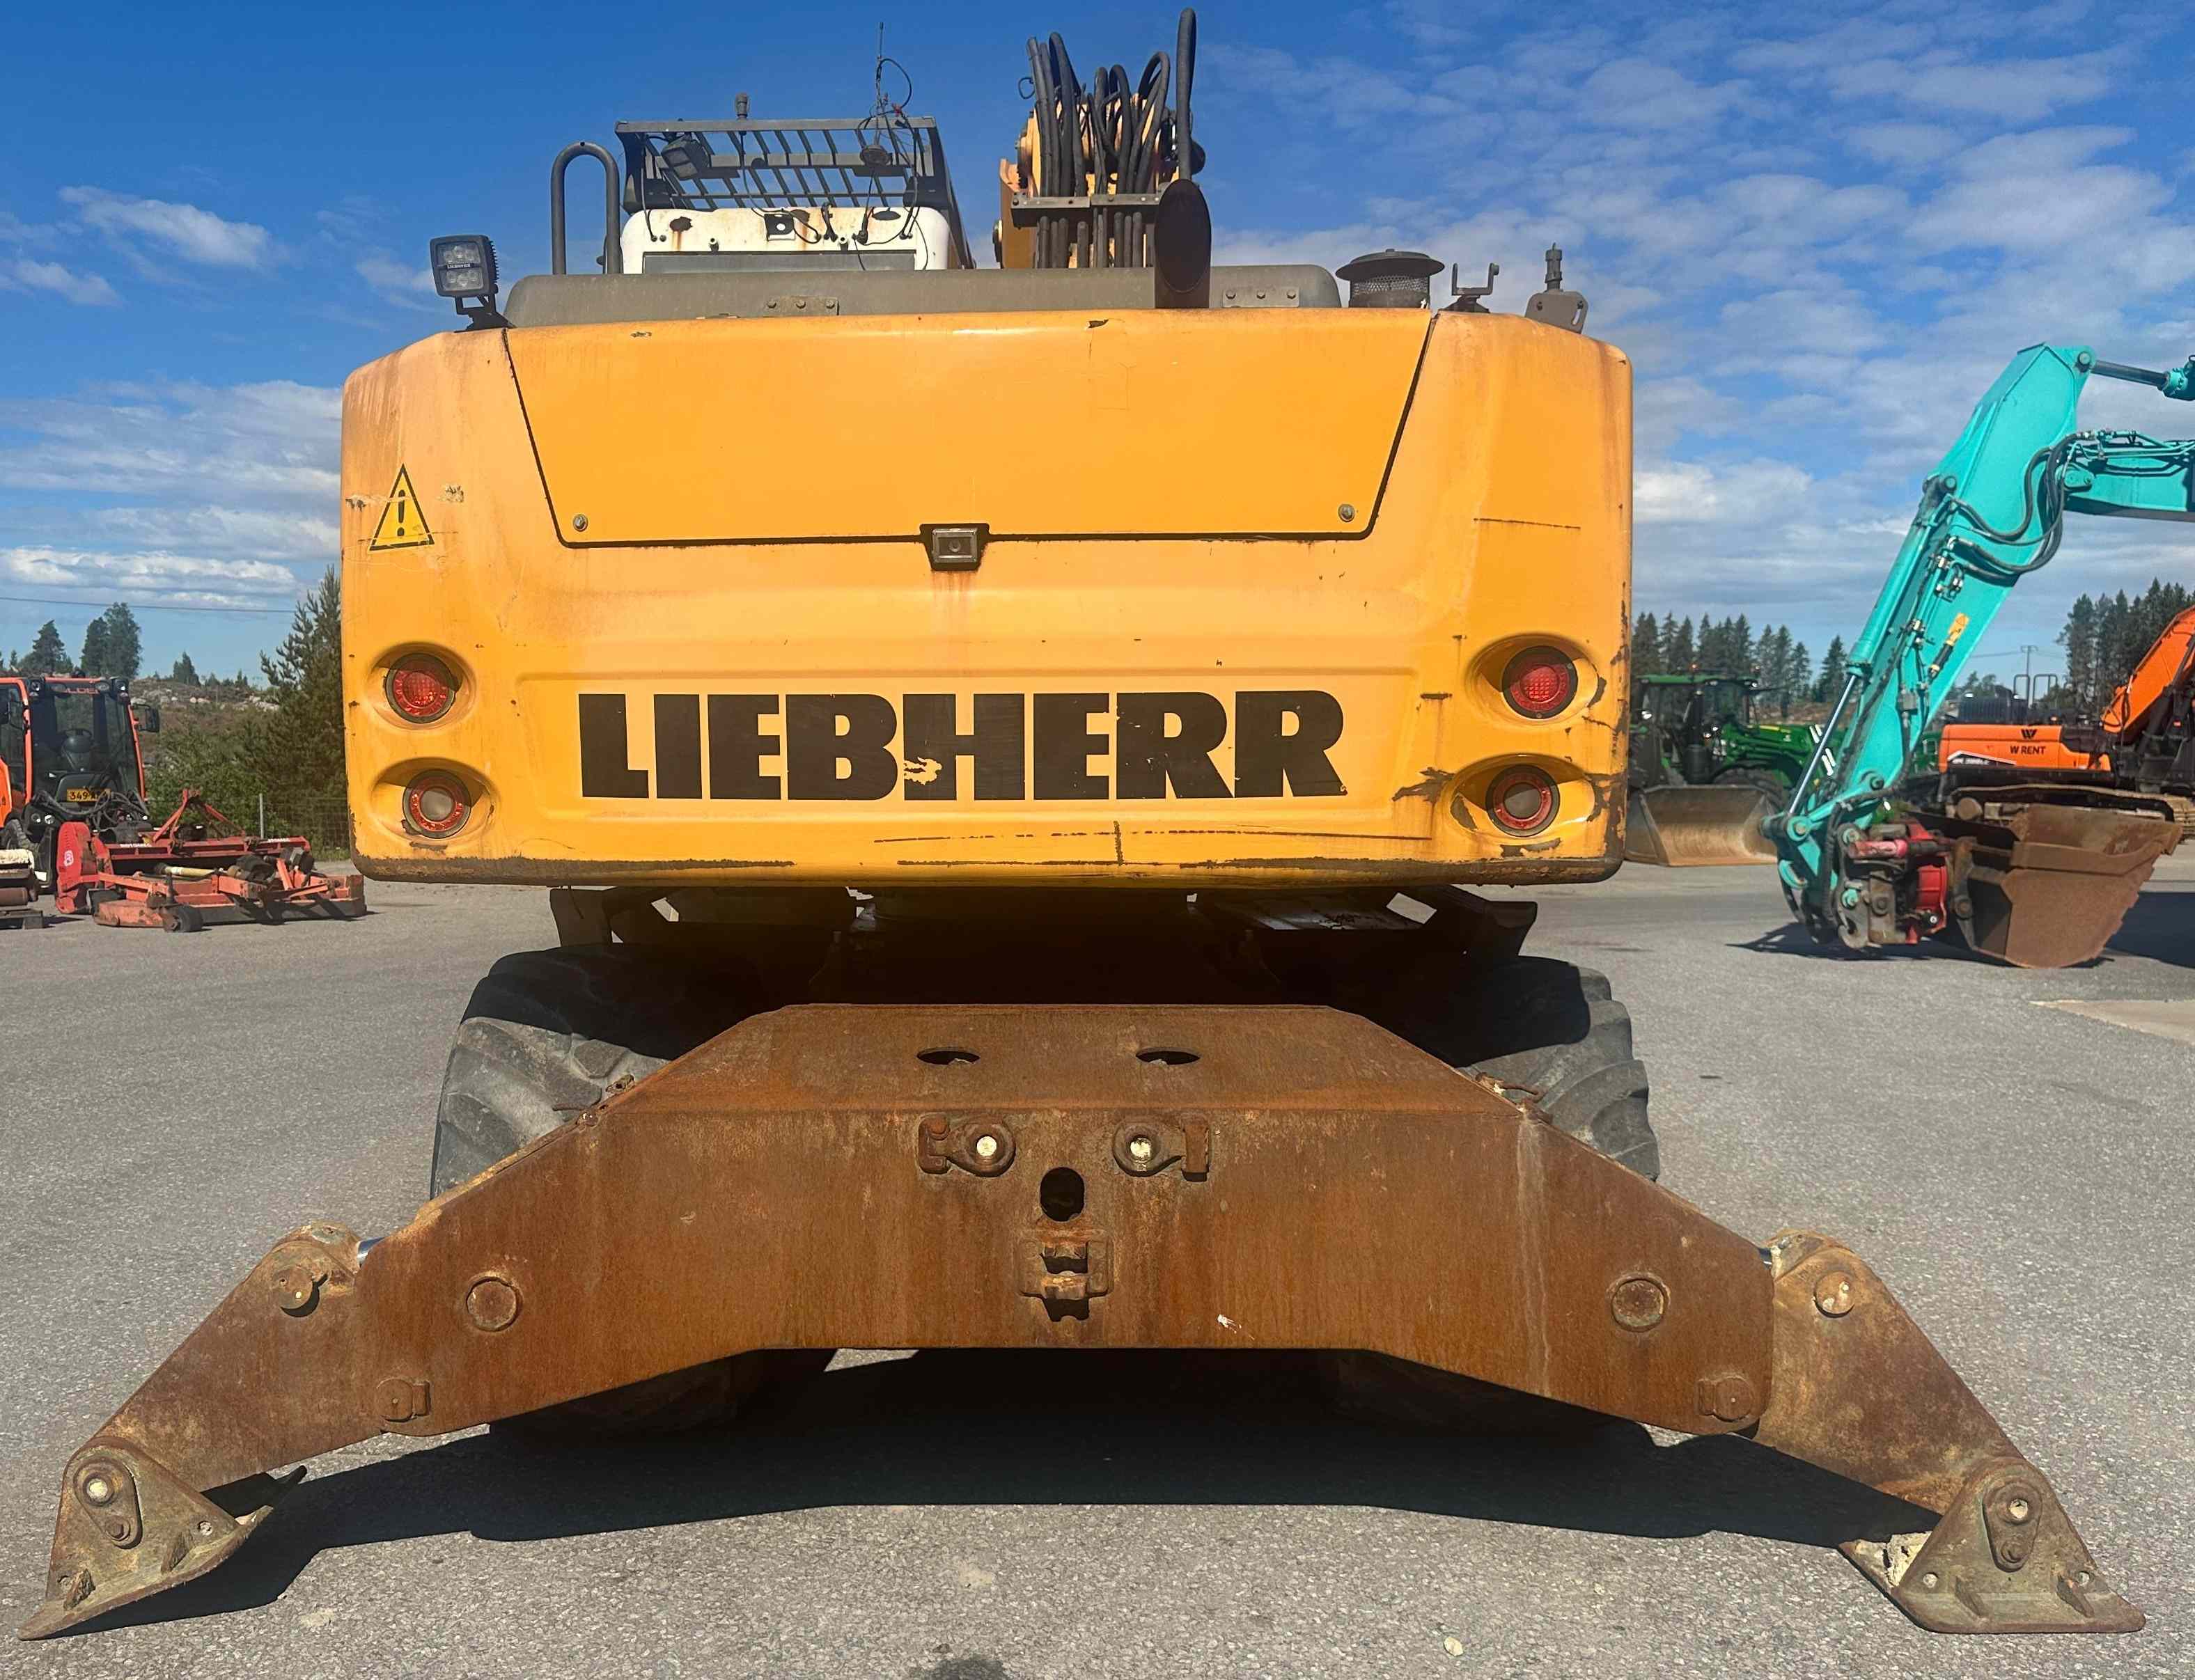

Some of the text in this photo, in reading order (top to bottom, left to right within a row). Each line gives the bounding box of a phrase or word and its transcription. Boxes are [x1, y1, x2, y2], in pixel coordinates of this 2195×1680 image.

[579, 690, 1348, 800] LIEBHERR
[2010, 746, 2046, 755] W RENT
